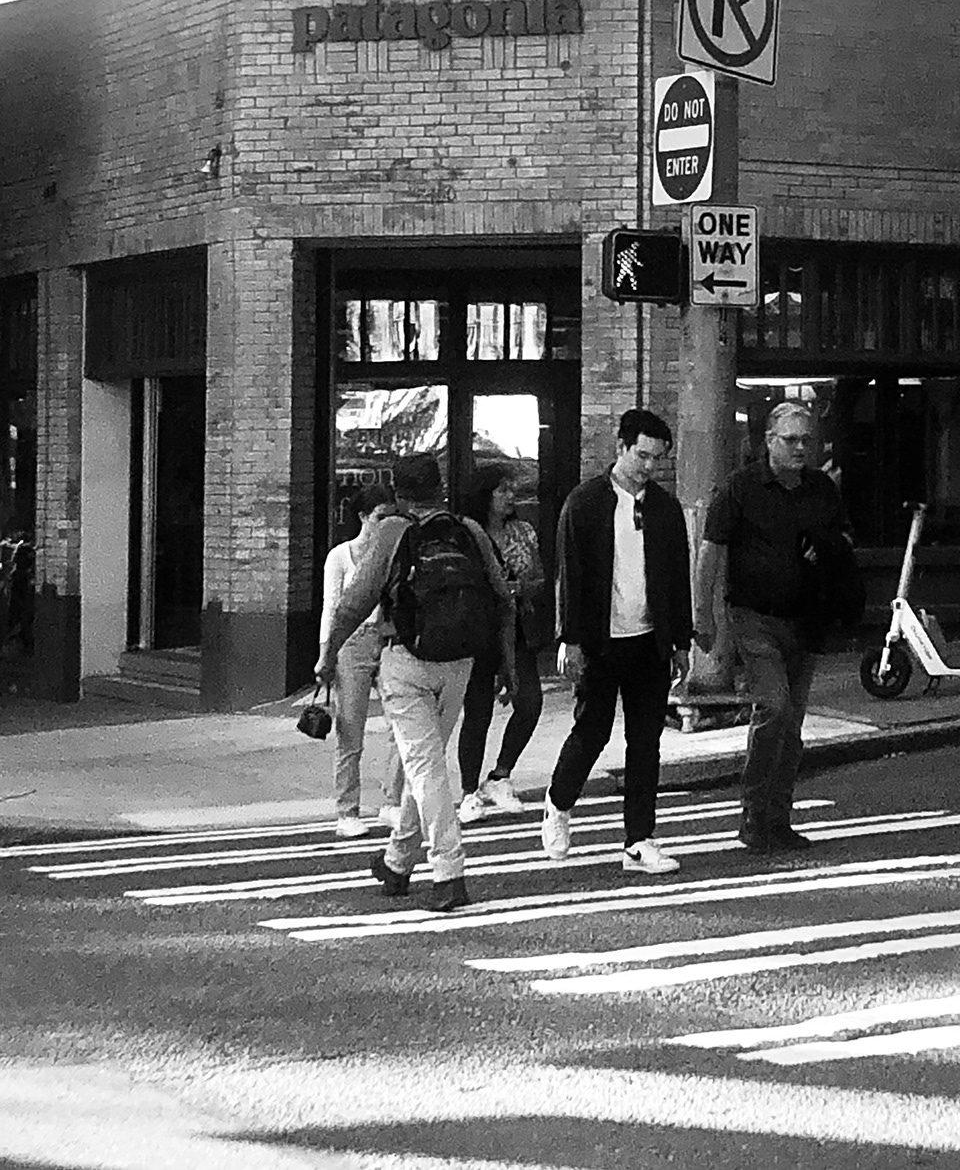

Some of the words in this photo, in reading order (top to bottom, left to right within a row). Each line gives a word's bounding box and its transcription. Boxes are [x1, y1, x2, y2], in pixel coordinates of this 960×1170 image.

[664, 103, 678, 122] DO
[684, 98, 705, 120] NOT
[666, 156, 699, 177] ENTER
[698, 212, 751, 236] ONE
[698, 240, 752, 265] WAY
